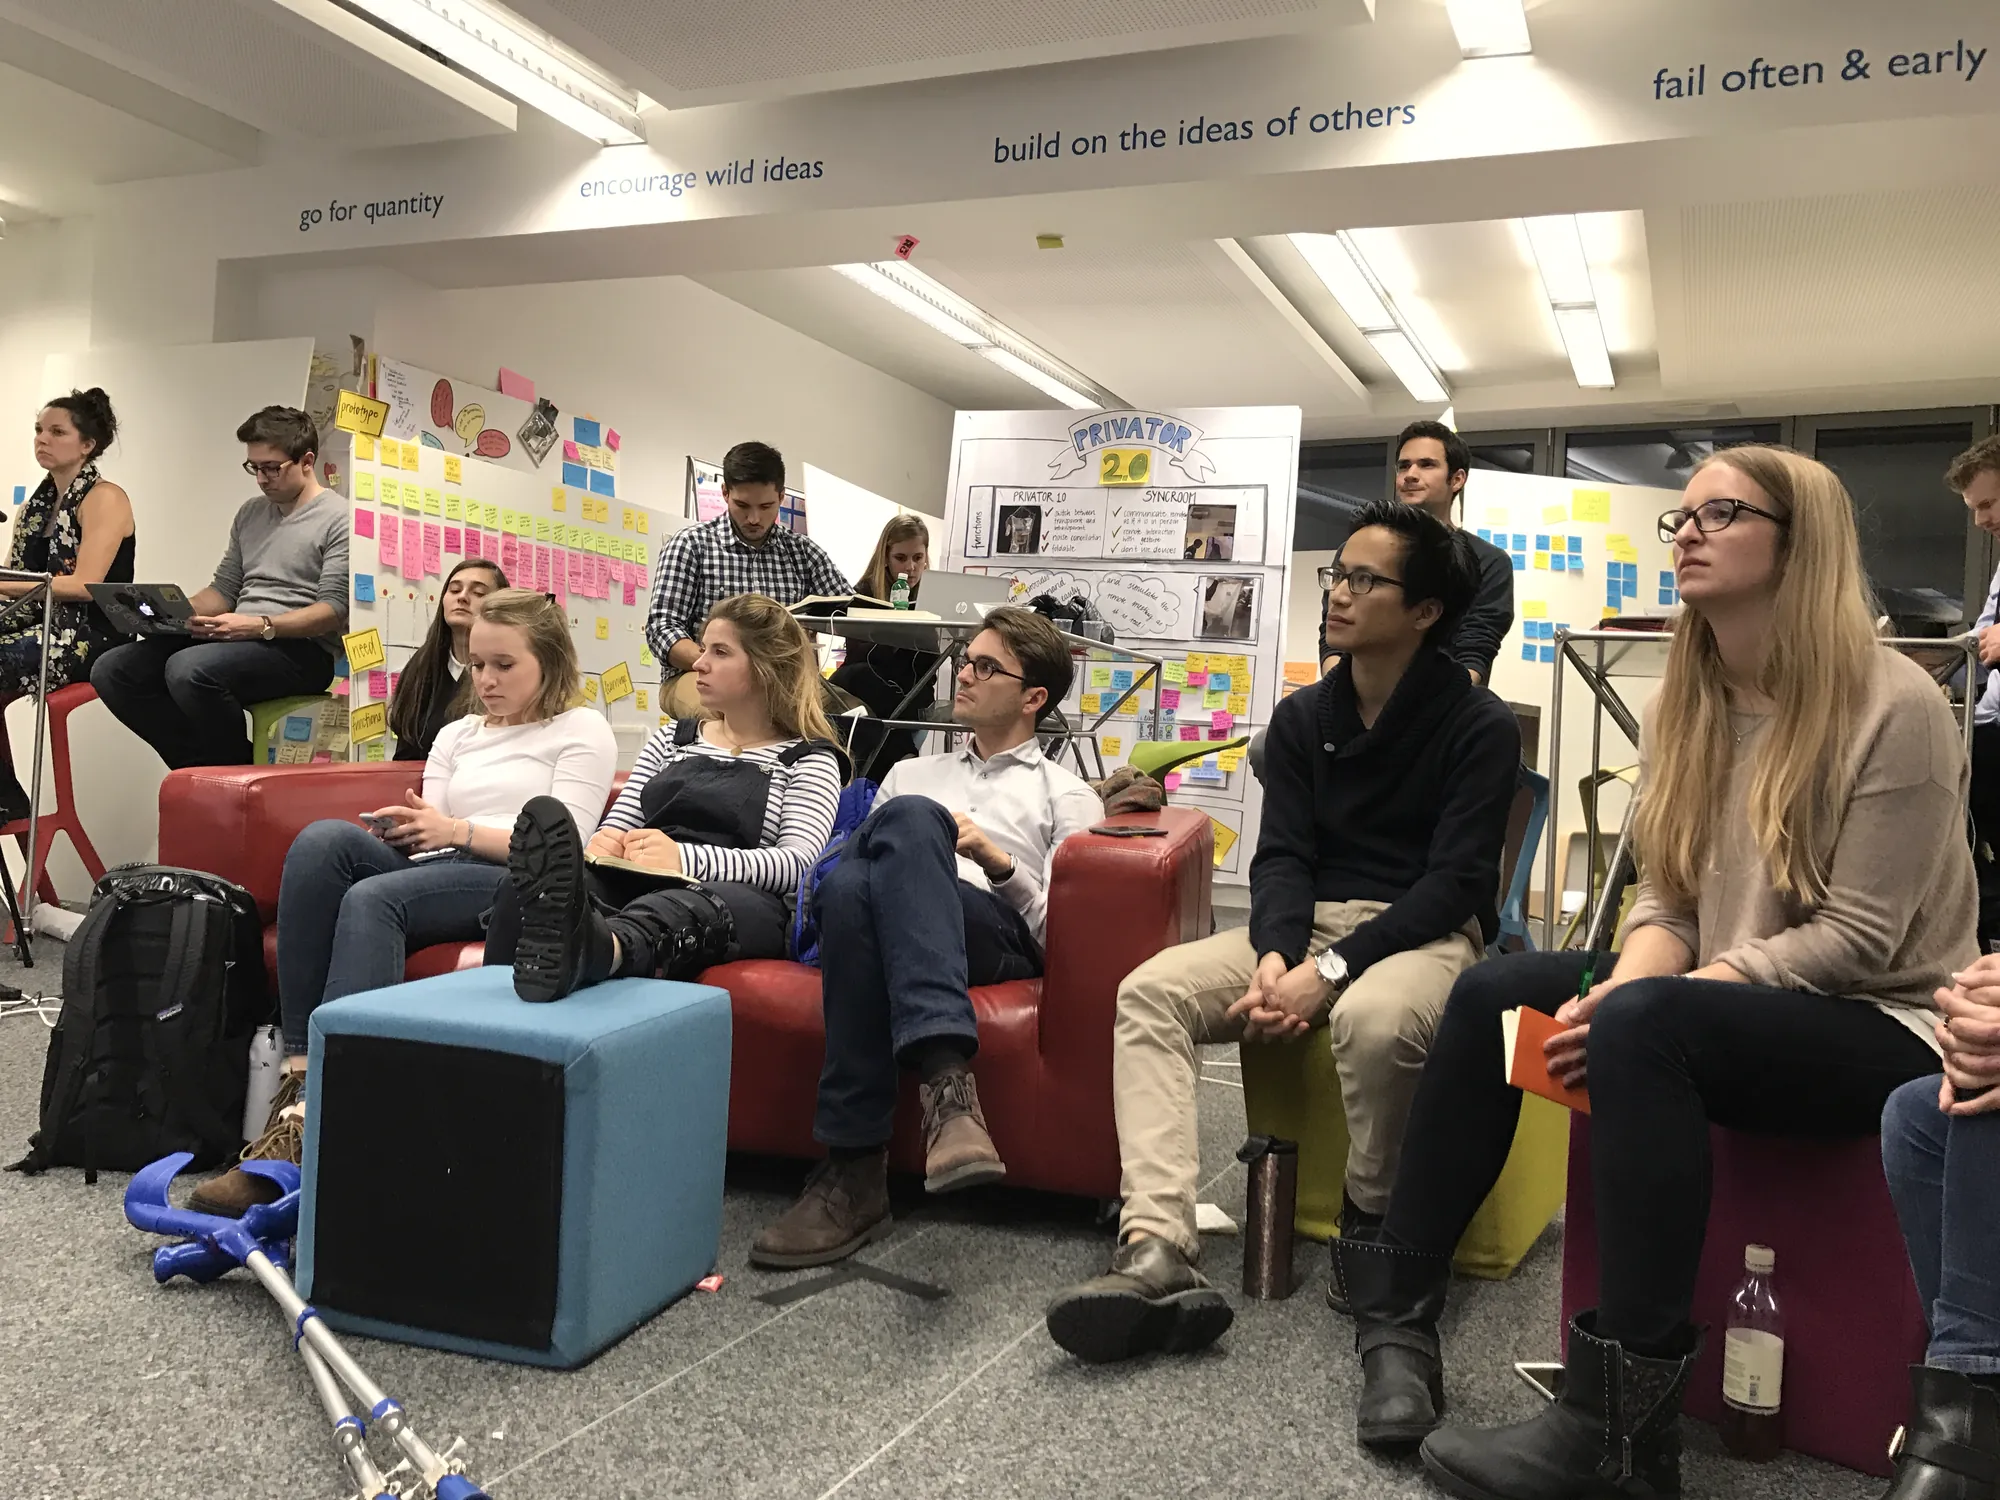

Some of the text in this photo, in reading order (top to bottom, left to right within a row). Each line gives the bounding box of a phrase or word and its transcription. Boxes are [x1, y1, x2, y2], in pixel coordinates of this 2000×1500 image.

[1653, 39, 1988, 100] fail often & early
[994, 102, 1416, 163] build on the ideas of others
[580, 158, 824, 198] encourage wild ideas
[299, 192, 444, 232] go for quantity
[341, 402, 379, 424] prototype
[1073, 417, 1192, 453] PRIVATOR
[1102, 452, 1149, 481] 2.0
[1013, 491, 1054, 503] PRIVATOR
[1142, 490, 1197, 504] SYNCROOM
[1123, 509, 1167, 518] communicate
[971, 510, 984, 550] functions
[1051, 544, 1076, 553] foldable
[1153, 546, 1177, 554] devices
[1106, 577, 1121, 586] and
[352, 636, 376, 660] need
[352, 711, 382, 737] functions
